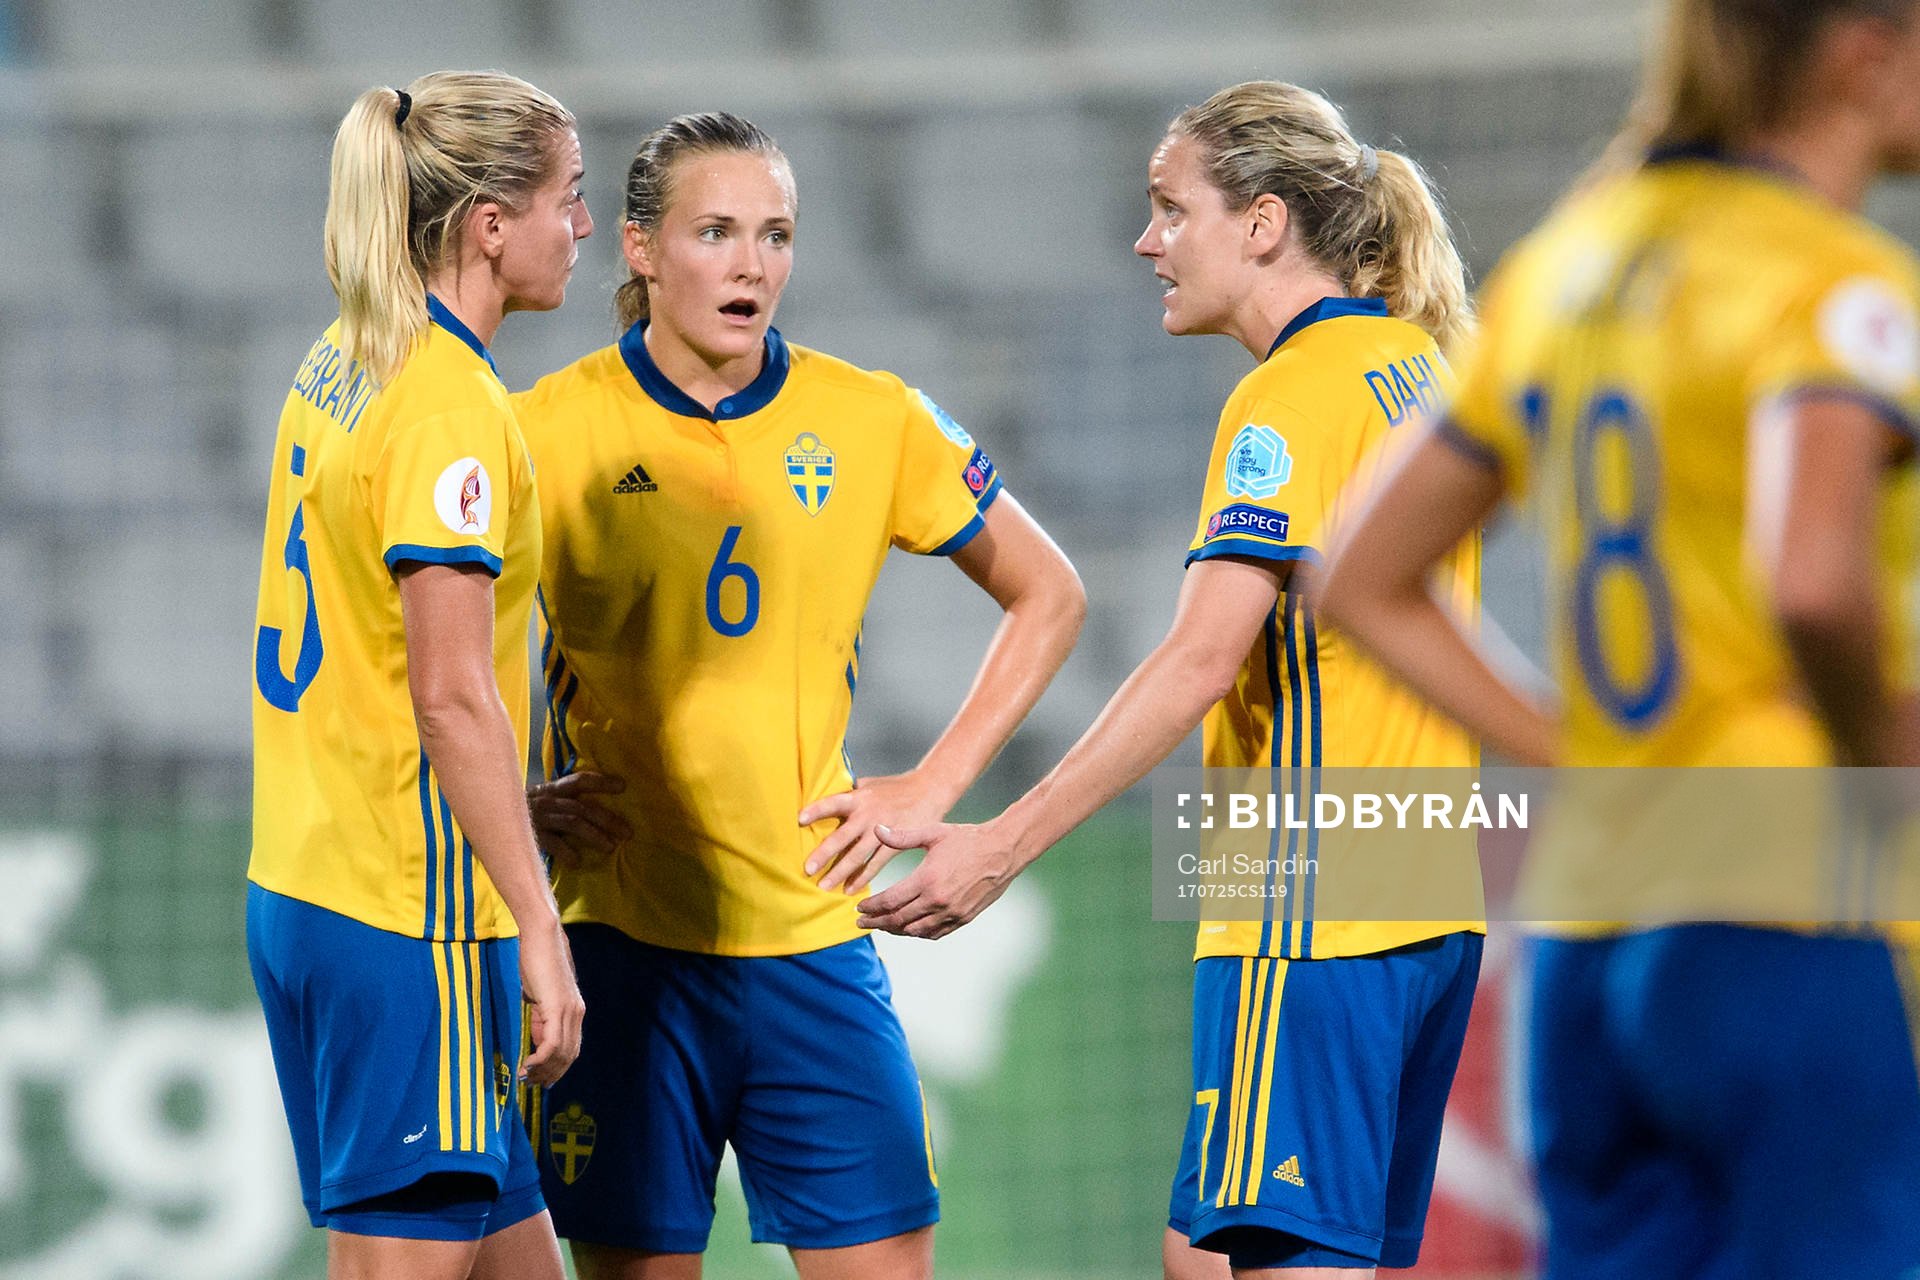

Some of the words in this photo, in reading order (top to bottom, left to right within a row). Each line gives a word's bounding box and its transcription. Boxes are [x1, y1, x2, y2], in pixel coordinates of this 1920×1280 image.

[790, 455, 828, 464] SVERIGE
[1237, 464, 1266, 477] strong
[612, 482, 658, 494] adidas
[1221, 511, 1289, 534] RESPECT
[705, 525, 760, 637] 6
[1196, 1088, 1220, 1202] 7
[1272, 1169, 1305, 1187] adidas
